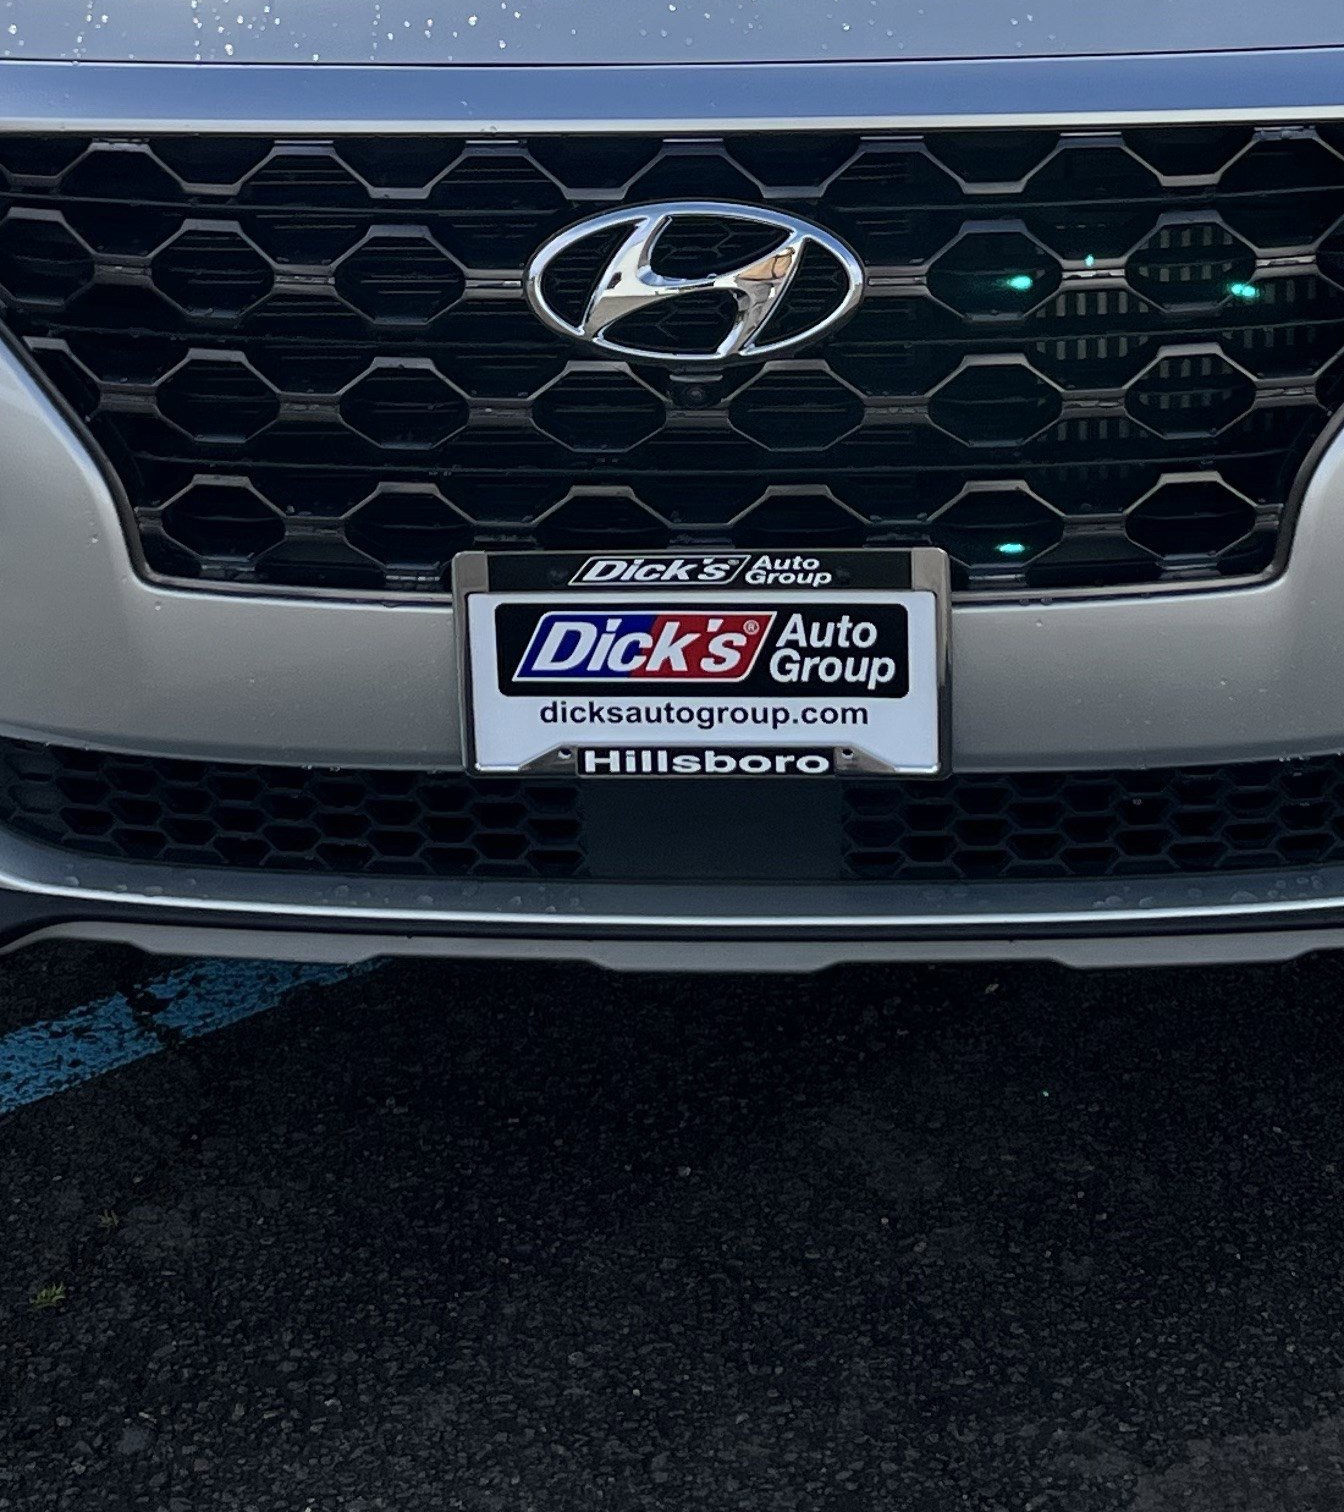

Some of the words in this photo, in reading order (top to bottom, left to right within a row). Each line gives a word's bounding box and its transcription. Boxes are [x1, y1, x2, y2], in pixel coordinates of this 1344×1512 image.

[582, 557, 730, 581] Dick's
[752, 555, 820, 571] Auto
[745, 570, 832, 587] Group
[776, 613, 877, 648] Auto
[532, 618, 746, 672] Dick's
[769, 648, 896, 690] Group
[540, 701, 869, 729] dicksautogroup.com
[584, 749, 830, 774] Hillsboro
